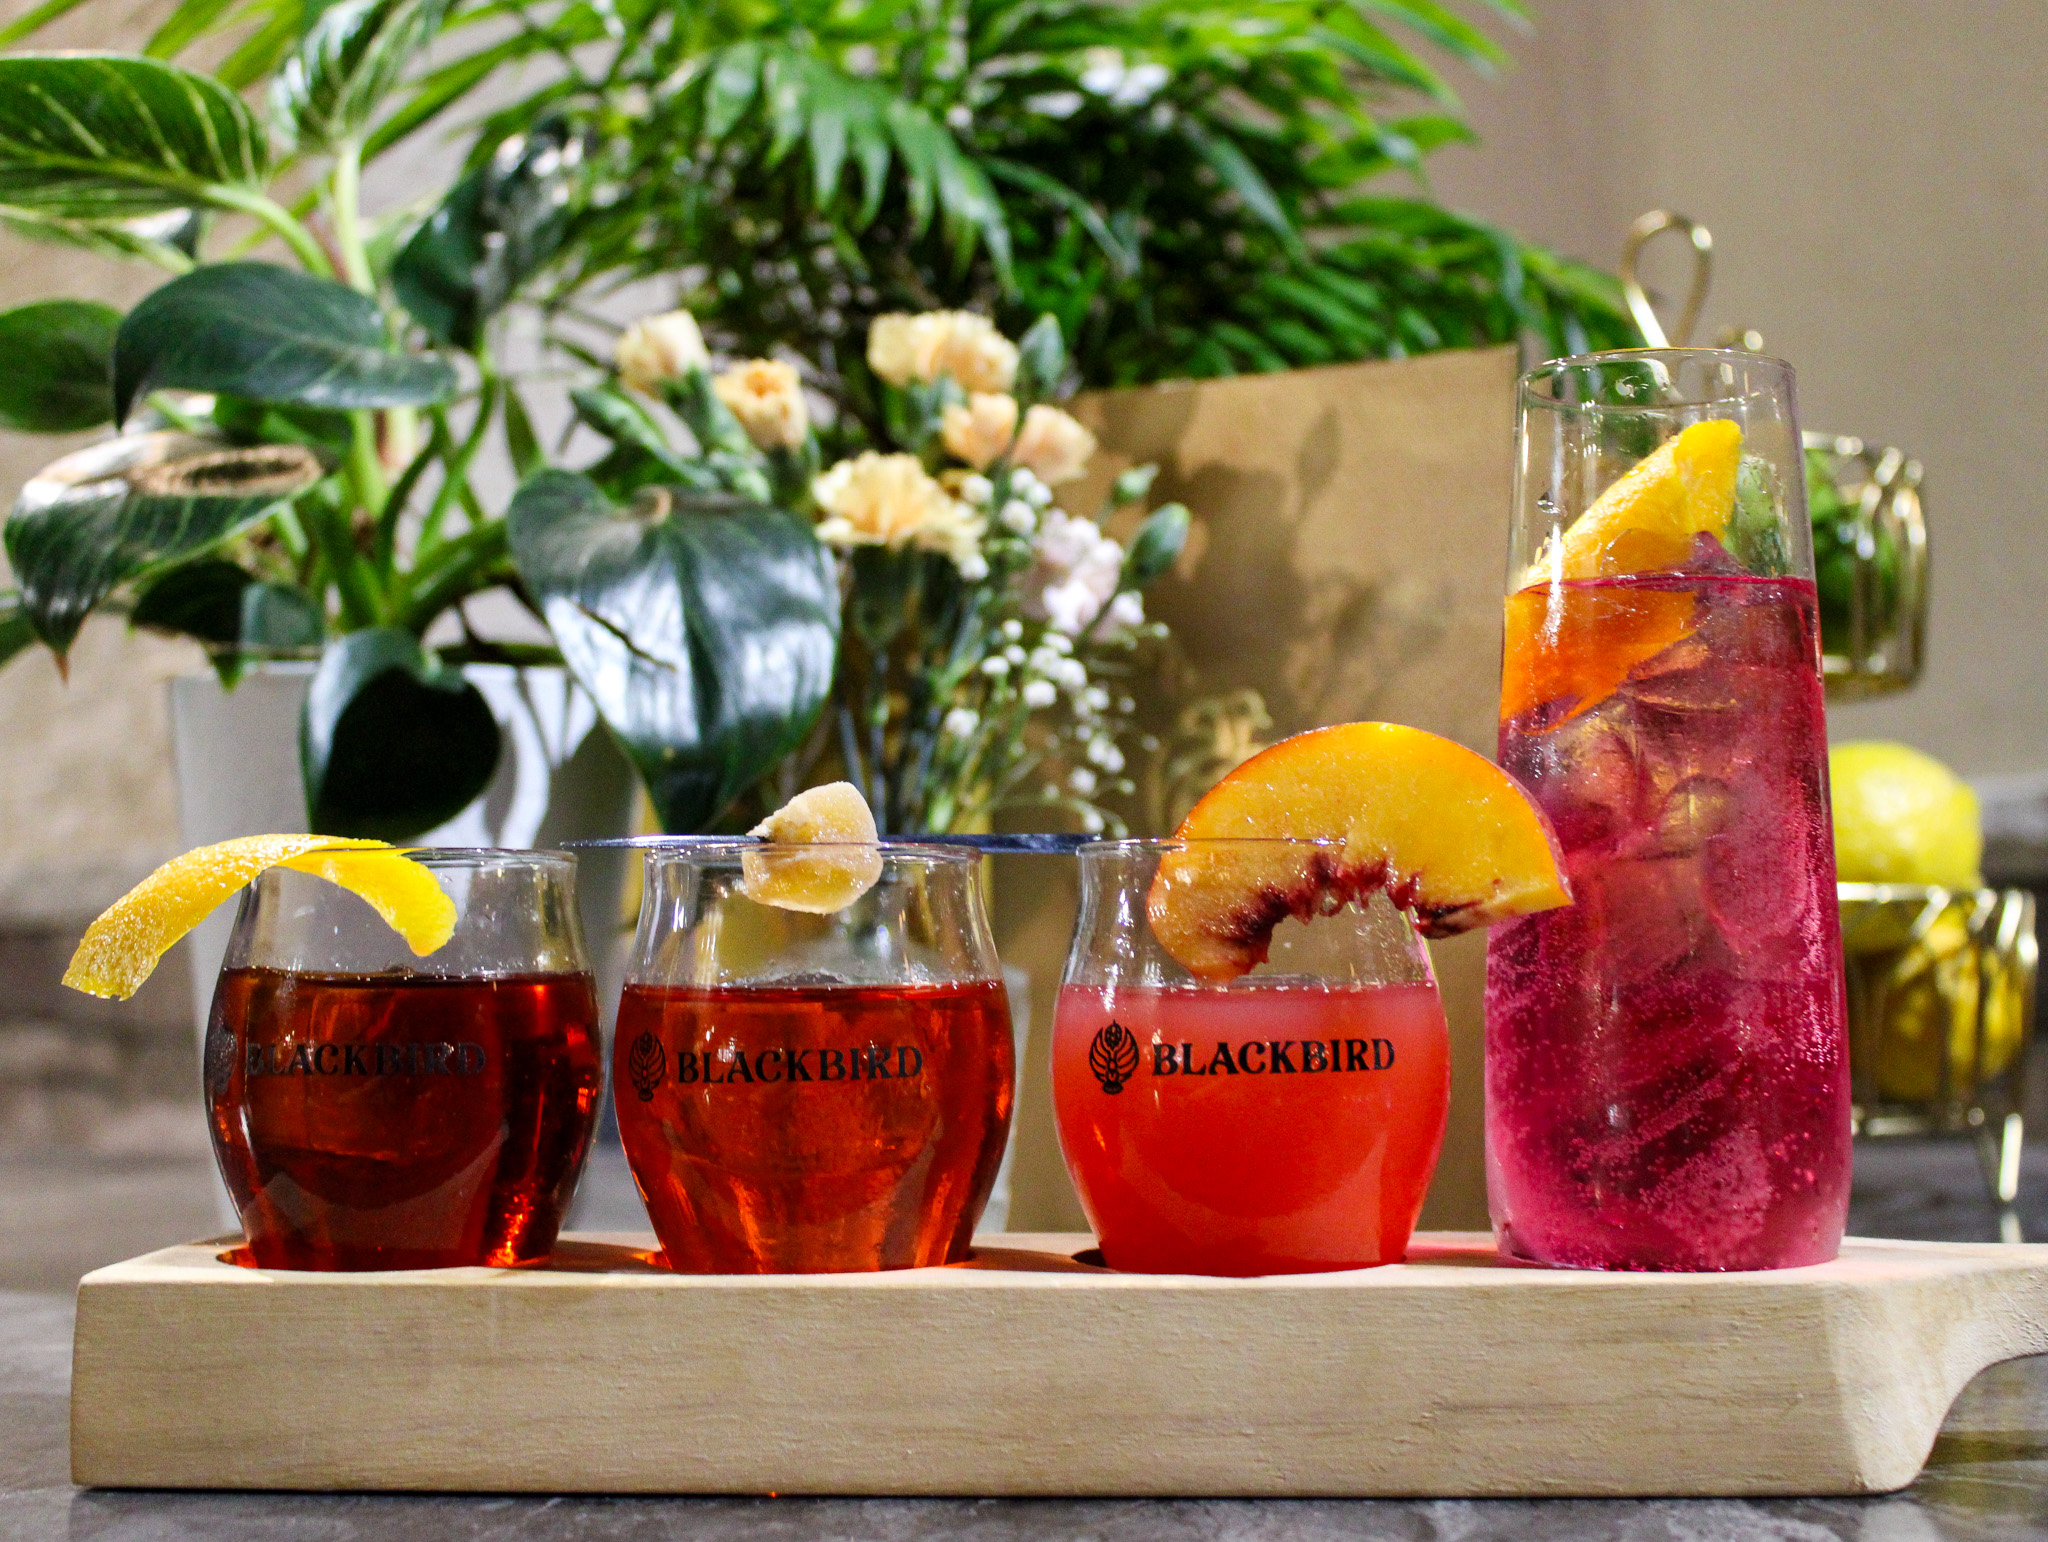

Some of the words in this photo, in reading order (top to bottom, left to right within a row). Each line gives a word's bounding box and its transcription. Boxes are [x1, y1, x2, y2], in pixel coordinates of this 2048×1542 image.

[246, 1042, 487, 1076] BLACKBIRD
[677, 1045, 923, 1084] BLACKBIRD
[1152, 1038, 1395, 1077] BLACKBIRD
